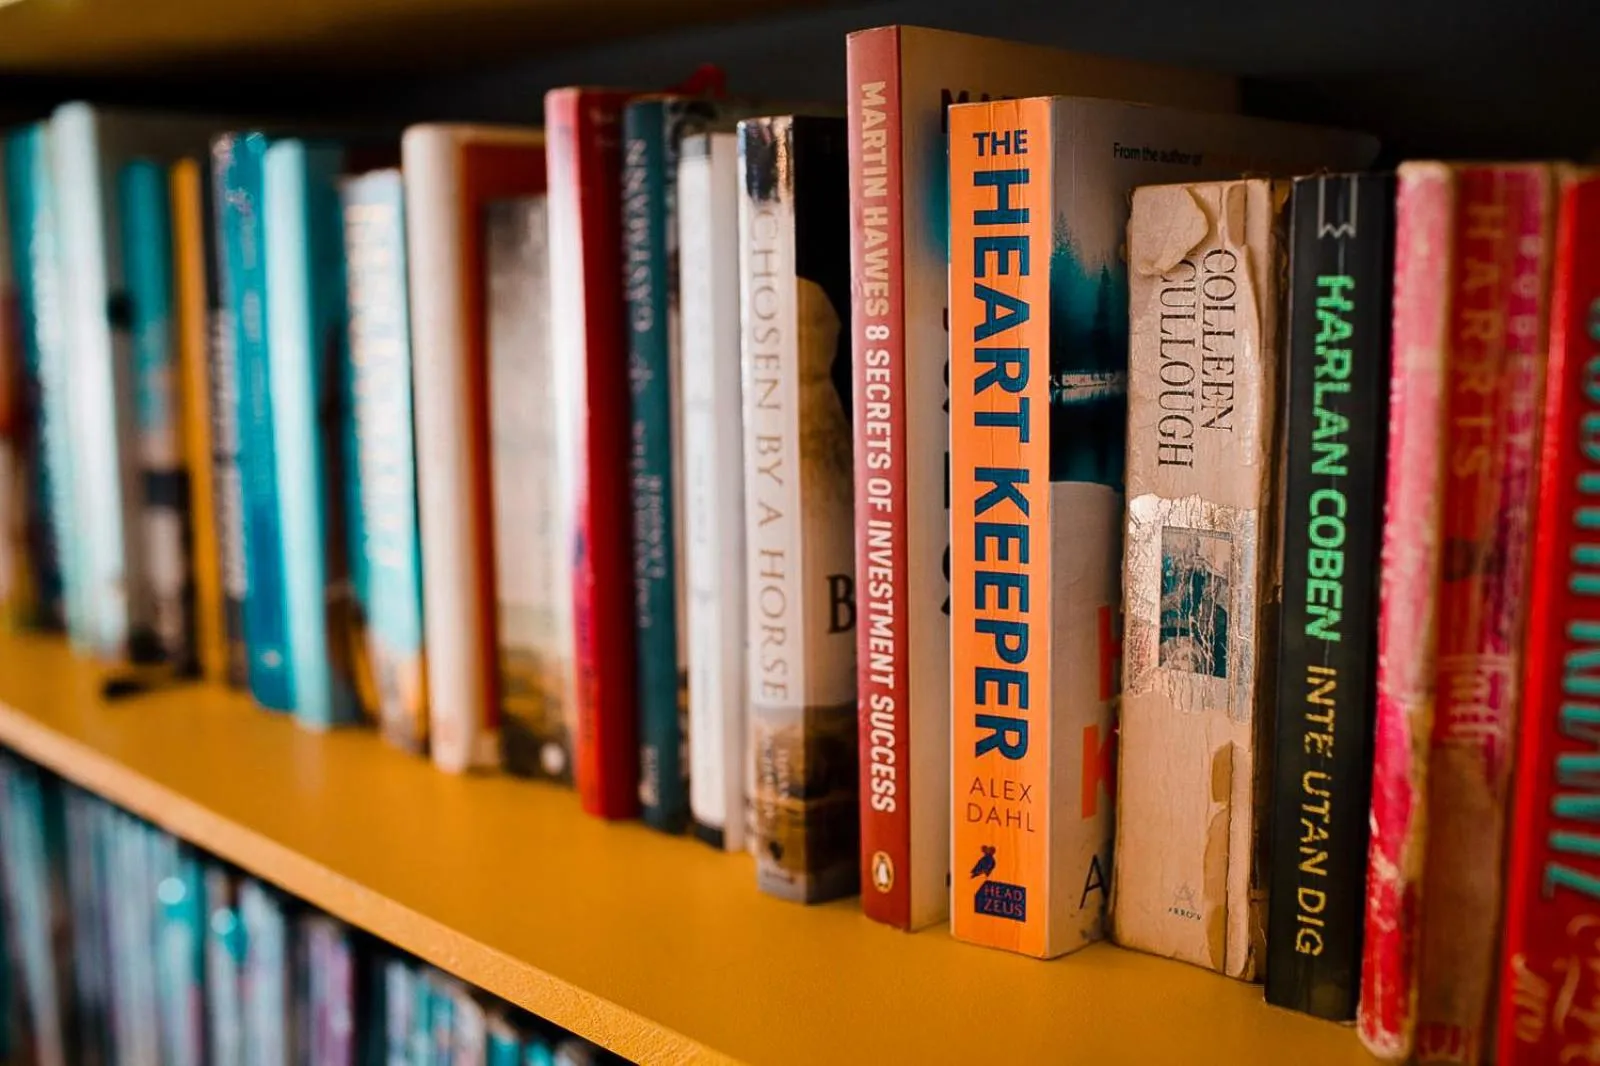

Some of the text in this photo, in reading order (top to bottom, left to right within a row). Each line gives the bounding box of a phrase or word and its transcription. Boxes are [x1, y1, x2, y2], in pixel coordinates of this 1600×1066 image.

[972, 129, 1029, 157] THE
[1113, 142, 1141, 161] From
[1142, 145, 1159, 162] the
[1159, 148, 1190, 165] author
[973, 168, 1030, 444] HEART
[1157, 259, 1196, 469] CULLOUGH
[1200, 248, 1237, 433] COLLEEN
[1451, 200, 1507, 479] HARRIS
[751, 207, 790, 701] CHOSEN BY A HORSE
[860, 80, 896, 814] MARTIN HAWES 8 SECRETS OF INVESTMENT SUCCESS
[1305, 274, 1355, 642] HARLAN COBEN
[974, 466, 1030, 761] KEEPER
[966, 801, 1036, 833] DAHL
[968, 776, 1033, 804] ALEX
[984, 885, 1023, 902] HEAD
[1294, 664, 1338, 957] INTE UTAN DIG
[983, 898, 1023, 916] ZEUS
